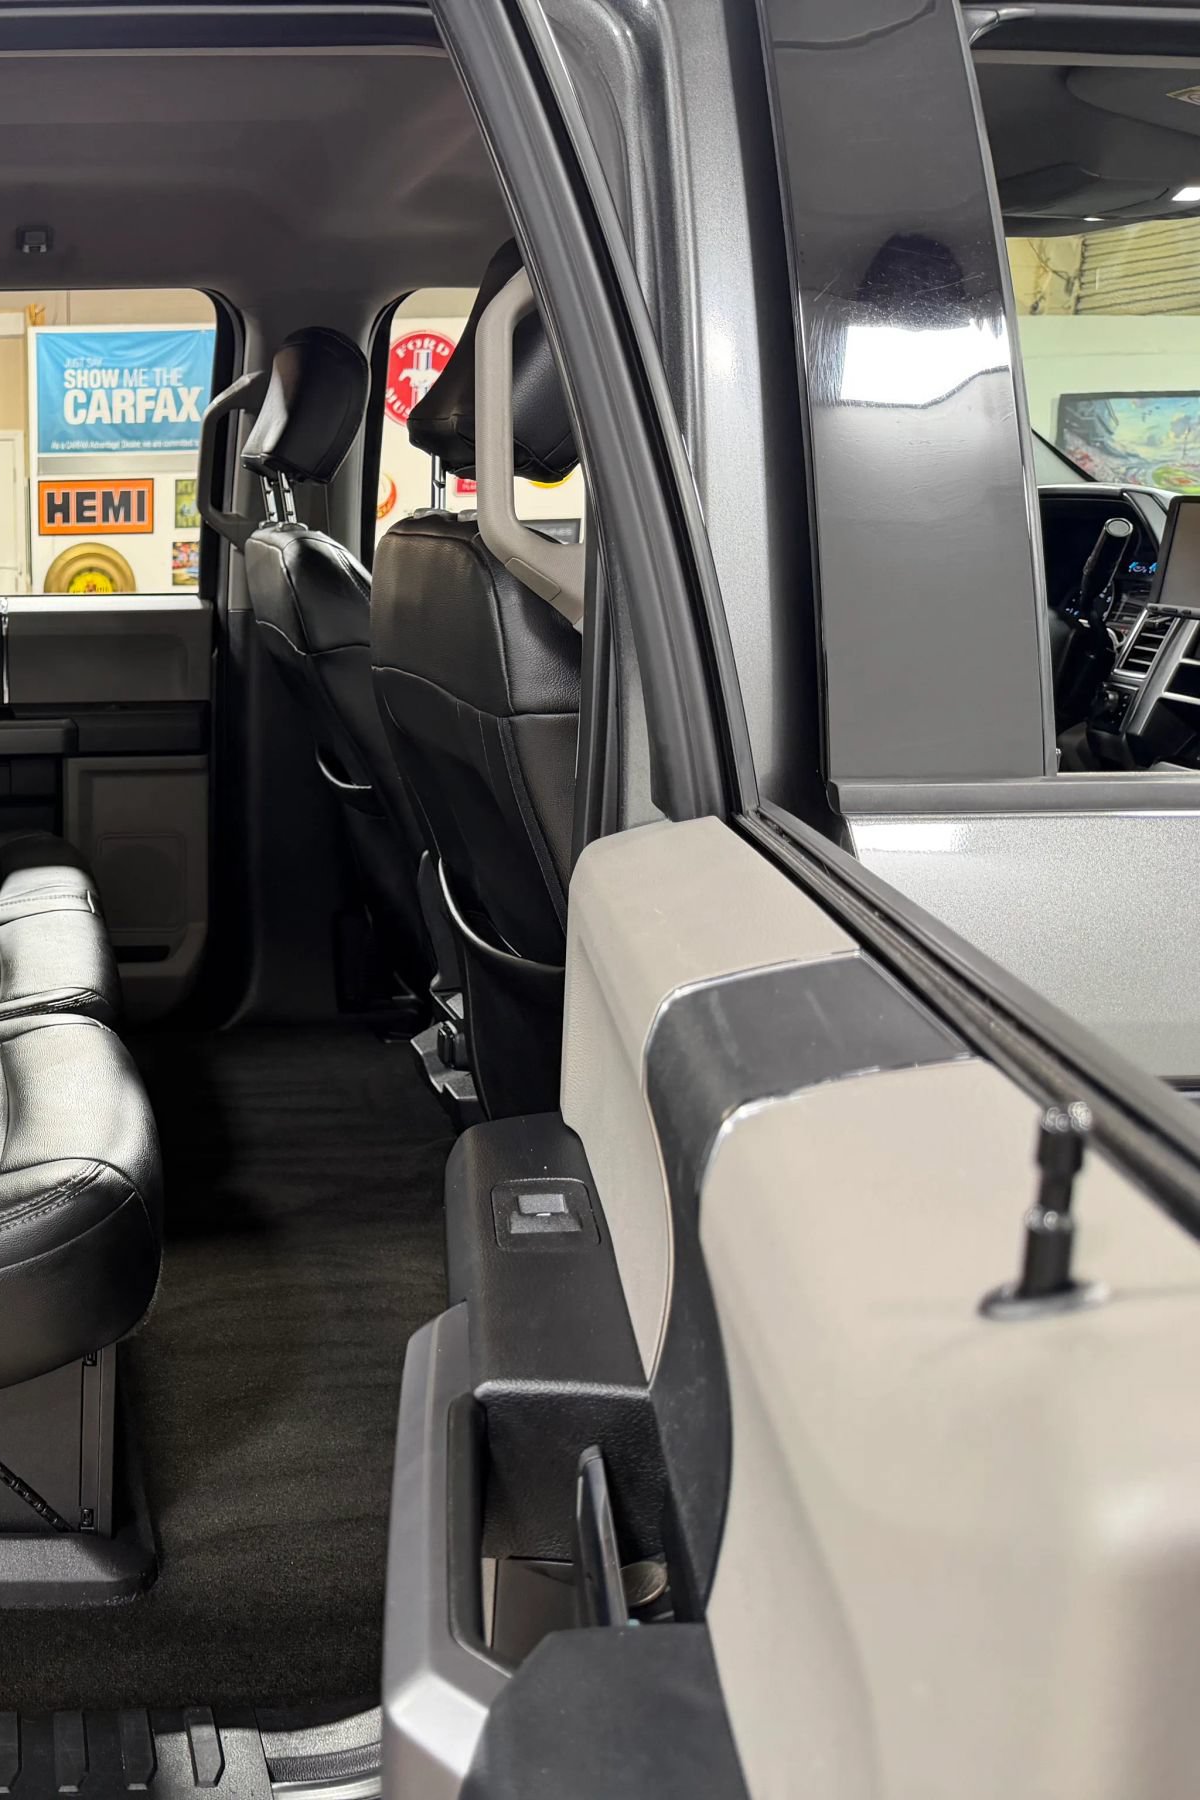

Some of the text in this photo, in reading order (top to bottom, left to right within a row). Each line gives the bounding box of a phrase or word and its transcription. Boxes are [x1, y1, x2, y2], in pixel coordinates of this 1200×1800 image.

[395, 337, 450, 359] FORD
[63, 367, 184, 389] SHOW ME THE
[63, 386, 205, 426] CARFAX
[46, 489, 146, 525] HEMI
